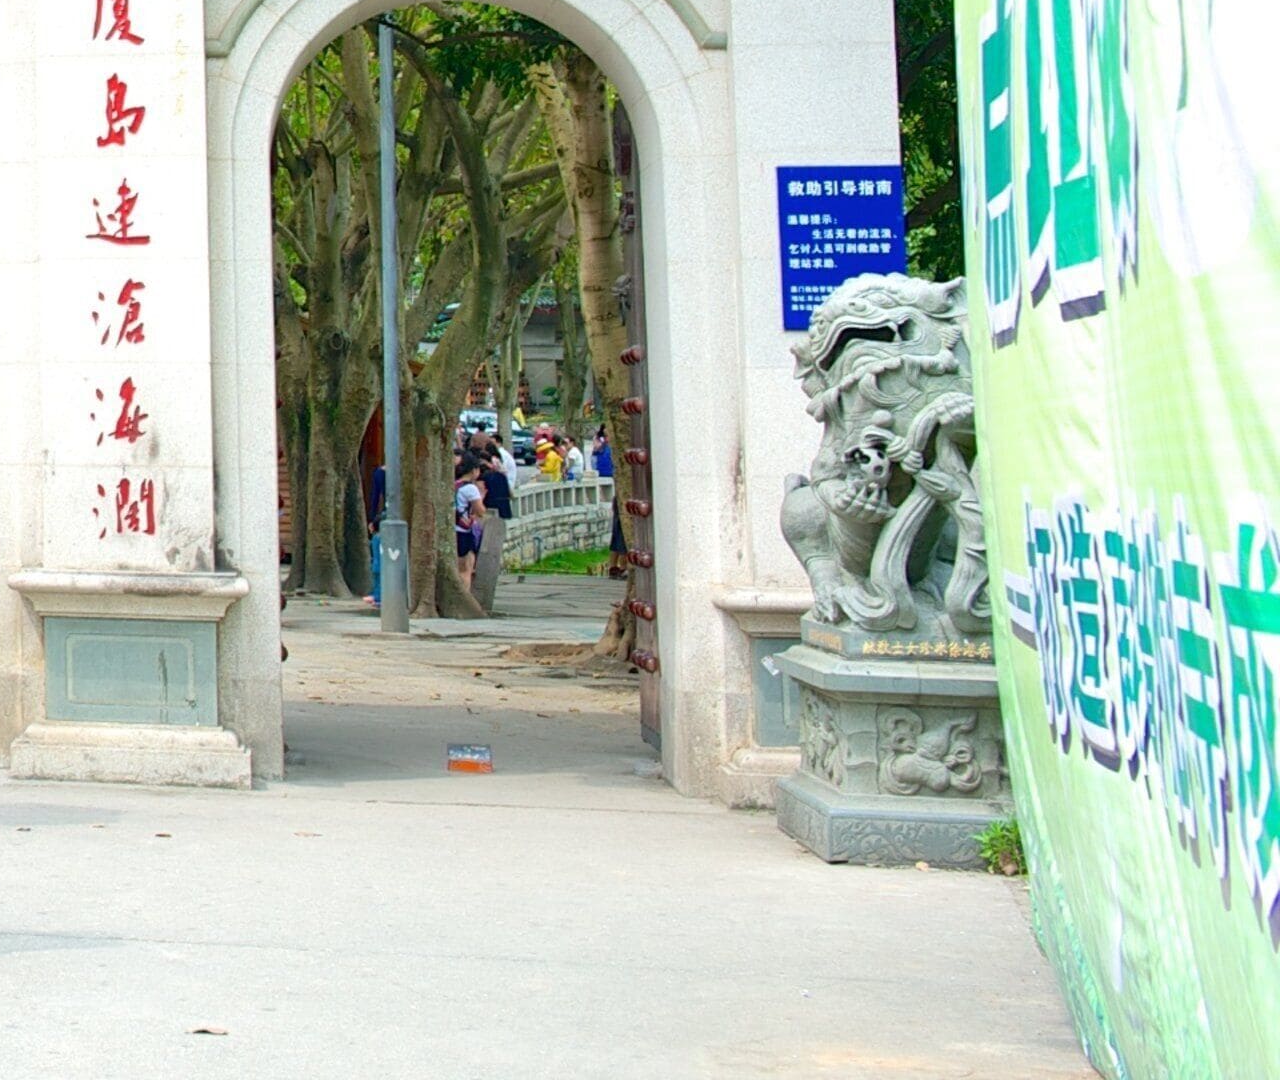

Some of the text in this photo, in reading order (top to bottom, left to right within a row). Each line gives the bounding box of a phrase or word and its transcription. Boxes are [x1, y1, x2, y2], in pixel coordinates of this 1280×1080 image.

[787, 180, 893, 197] 救助引导指南
